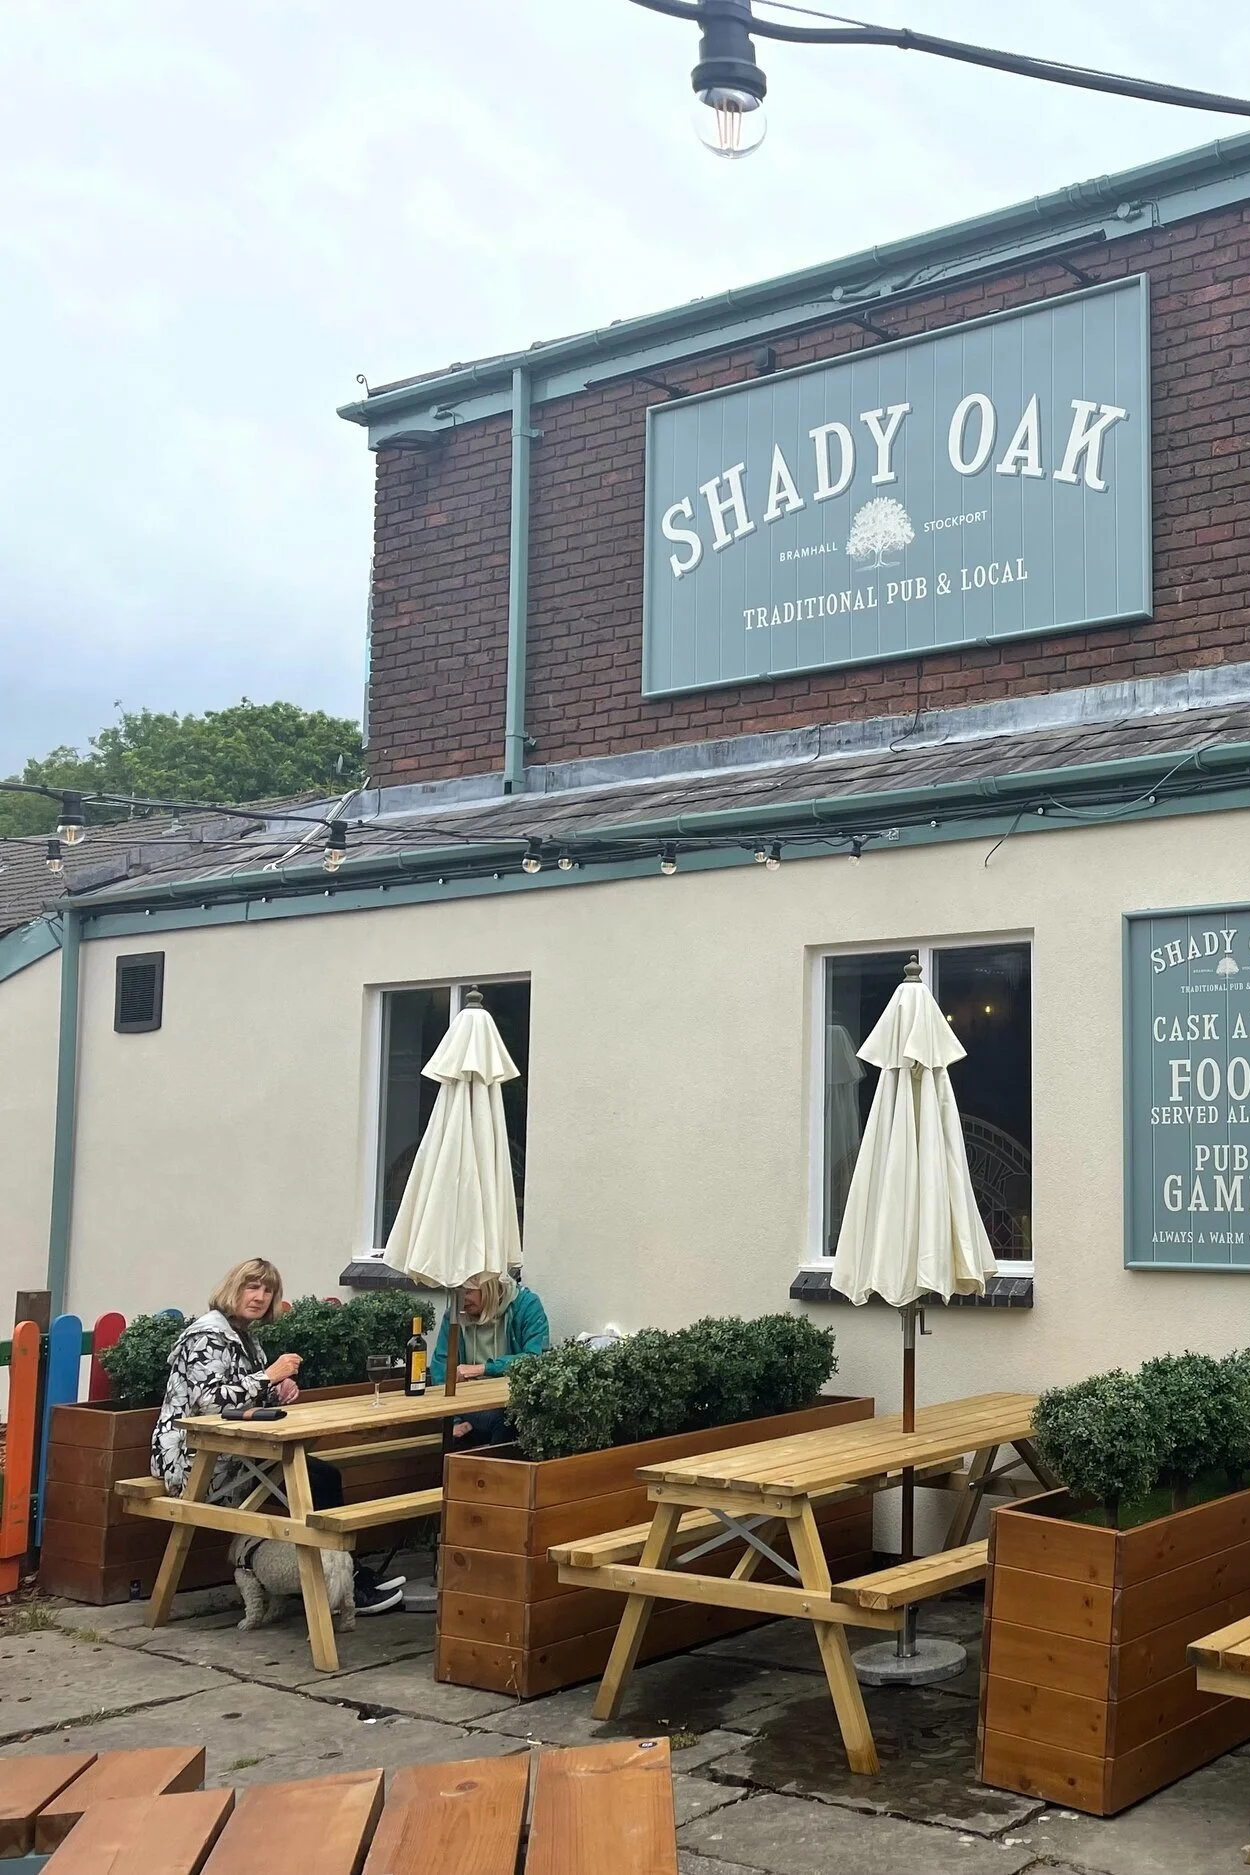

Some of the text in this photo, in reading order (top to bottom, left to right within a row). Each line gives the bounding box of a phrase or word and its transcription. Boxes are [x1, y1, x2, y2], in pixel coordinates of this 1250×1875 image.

[661, 392, 1128, 578] SHADY OAK
[923, 510, 987, 533] STOCKPORT
[779, 541, 838, 562] BRAMHALL
[743, 558, 1028, 630] TRADITIONAL PUB & LOCAL
[1150, 929, 1238, 975] SHADY
[1180, 983, 1228, 994] TRADITIONAL
[1230, 982, 1244, 991] PUB
[1154, 1013, 1220, 1042] CASK
[1150, 1106, 1219, 1126] SERVED
[1194, 1144, 1249, 1172] PUB
[1152, 1231, 1194, 1244] ALWAYS
[1197, 1231, 1205, 1244] A
[1209, 1231, 1245, 1245] WARM
